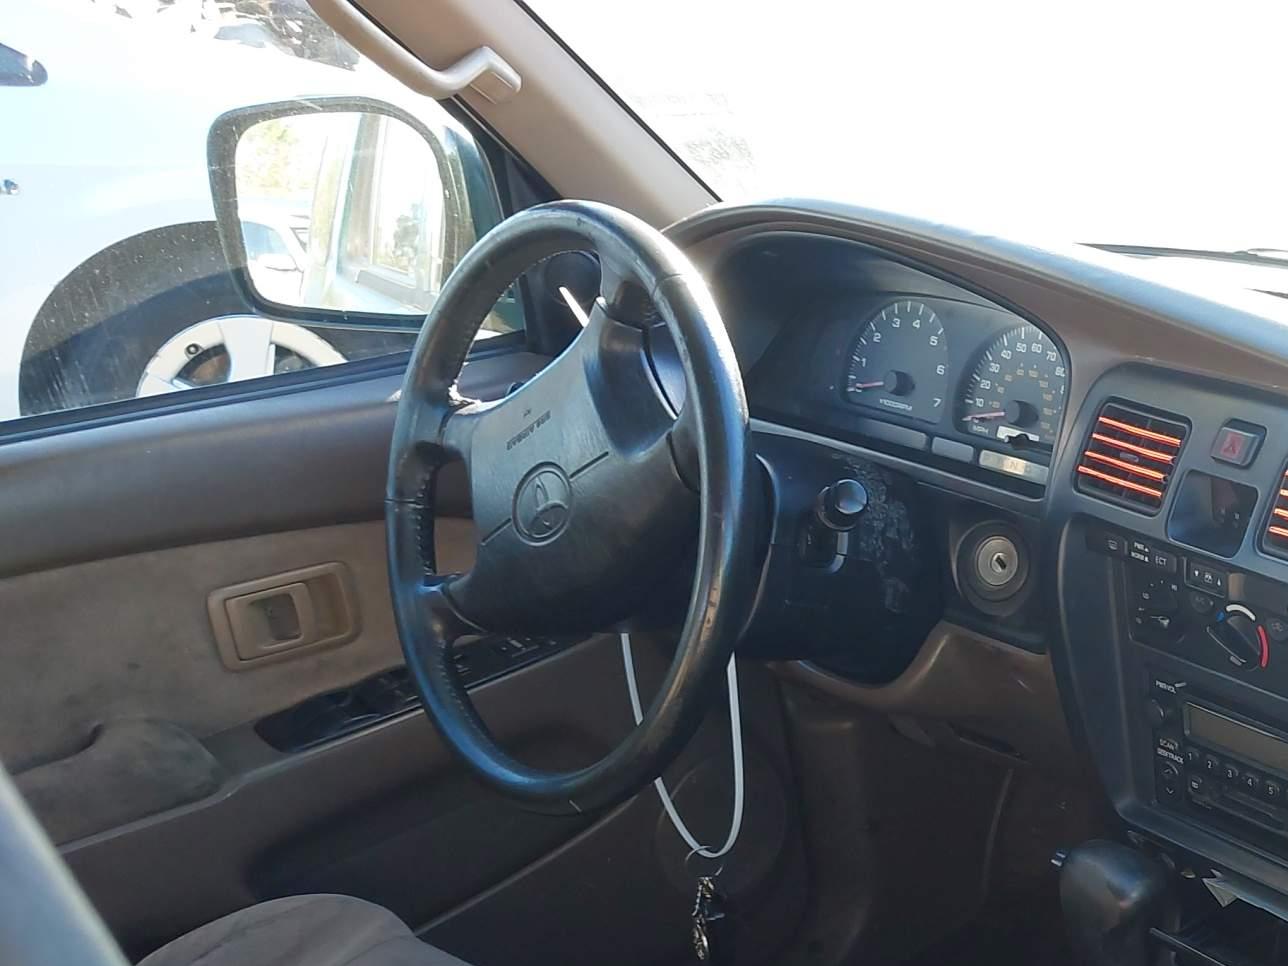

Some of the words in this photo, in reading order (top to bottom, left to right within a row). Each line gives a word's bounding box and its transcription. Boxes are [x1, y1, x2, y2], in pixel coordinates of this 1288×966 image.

[891, 318, 901, 328] 3
[912, 319, 921, 329] 4
[873, 332, 882, 343] 2
[929, 335, 939, 347] 5
[1015, 342, 1028, 353] 50
[1031, 342, 1043, 353] 60
[1000, 349, 1013, 360] 40
[1045, 350, 1057, 362] 70
[936, 364, 945, 376] 6
[988, 362, 1001, 374] 30
[979, 379, 991, 390] 20
[932, 397, 942, 408] 7
[974, 398, 985, 408] 10
[1155, 555, 1168, 567] ECT
[1207, 760, 1213, 769] 2
[1227, 769, 1233, 779] 3
[1247, 778, 1253, 787] 4
[1268, 786, 1274, 795] 5
